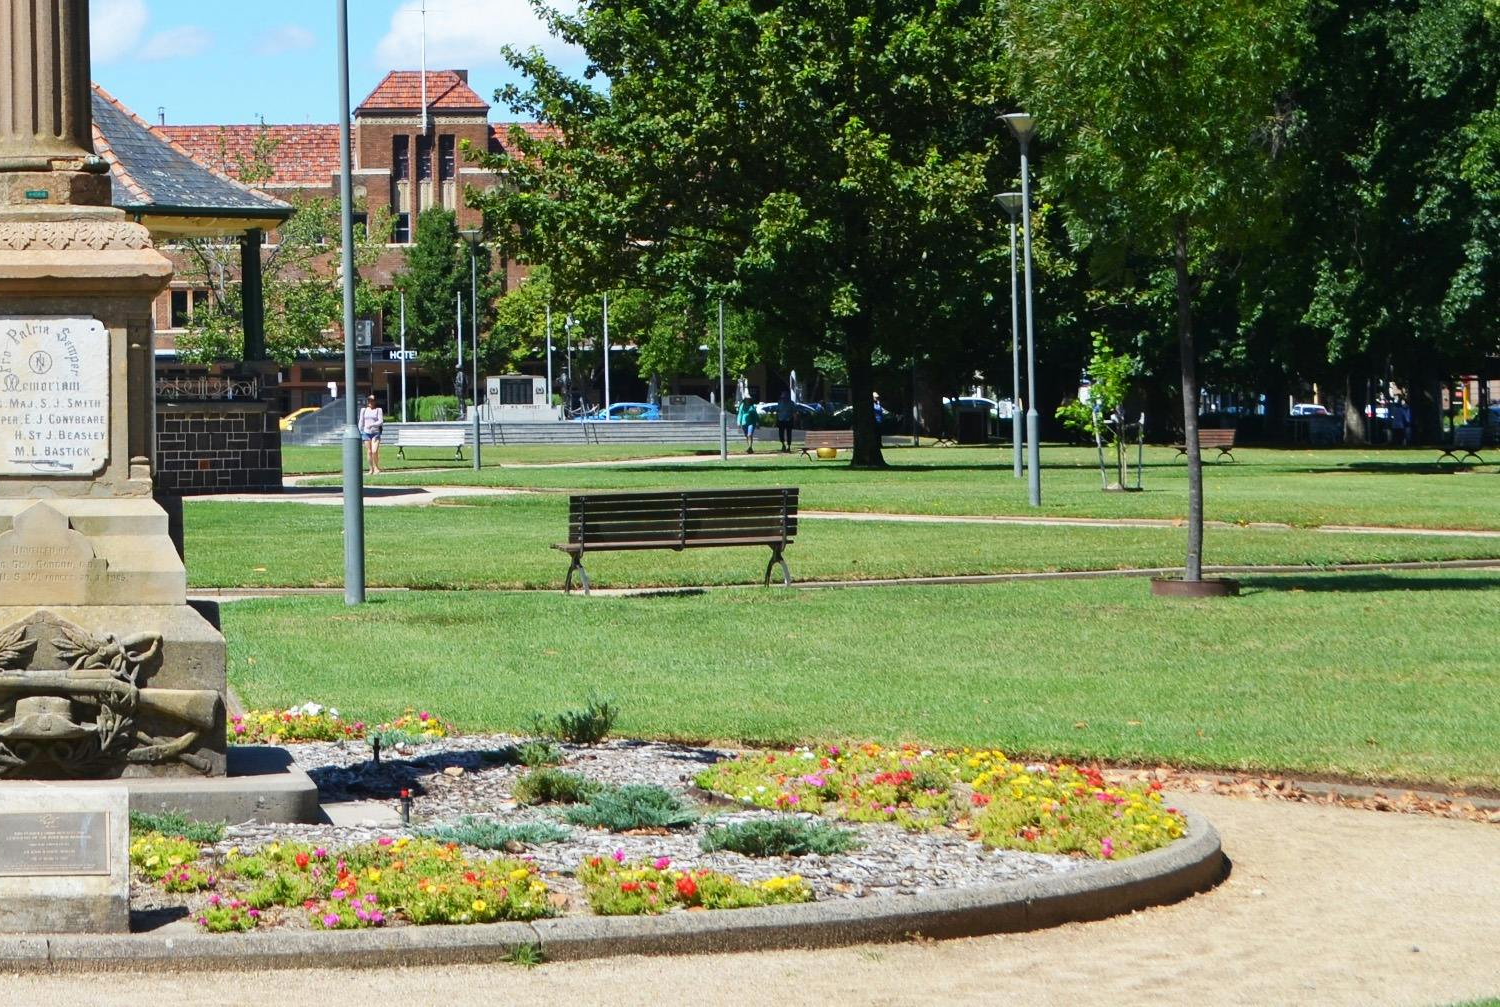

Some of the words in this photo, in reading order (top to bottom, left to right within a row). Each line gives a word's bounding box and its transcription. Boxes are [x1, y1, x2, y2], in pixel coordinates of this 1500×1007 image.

[6, 322, 50, 345] Patria
[56, 327, 79, 377] Semper
[390, 351, 418, 359] HOTEL
[2, 373, 80, 392] Memoriam
[67, 398, 101, 408] SMITH
[48, 414, 105, 425] CONYBEARE
[58, 430, 106, 440] BEASLEY
[44, 446, 91, 457] BASTICK
